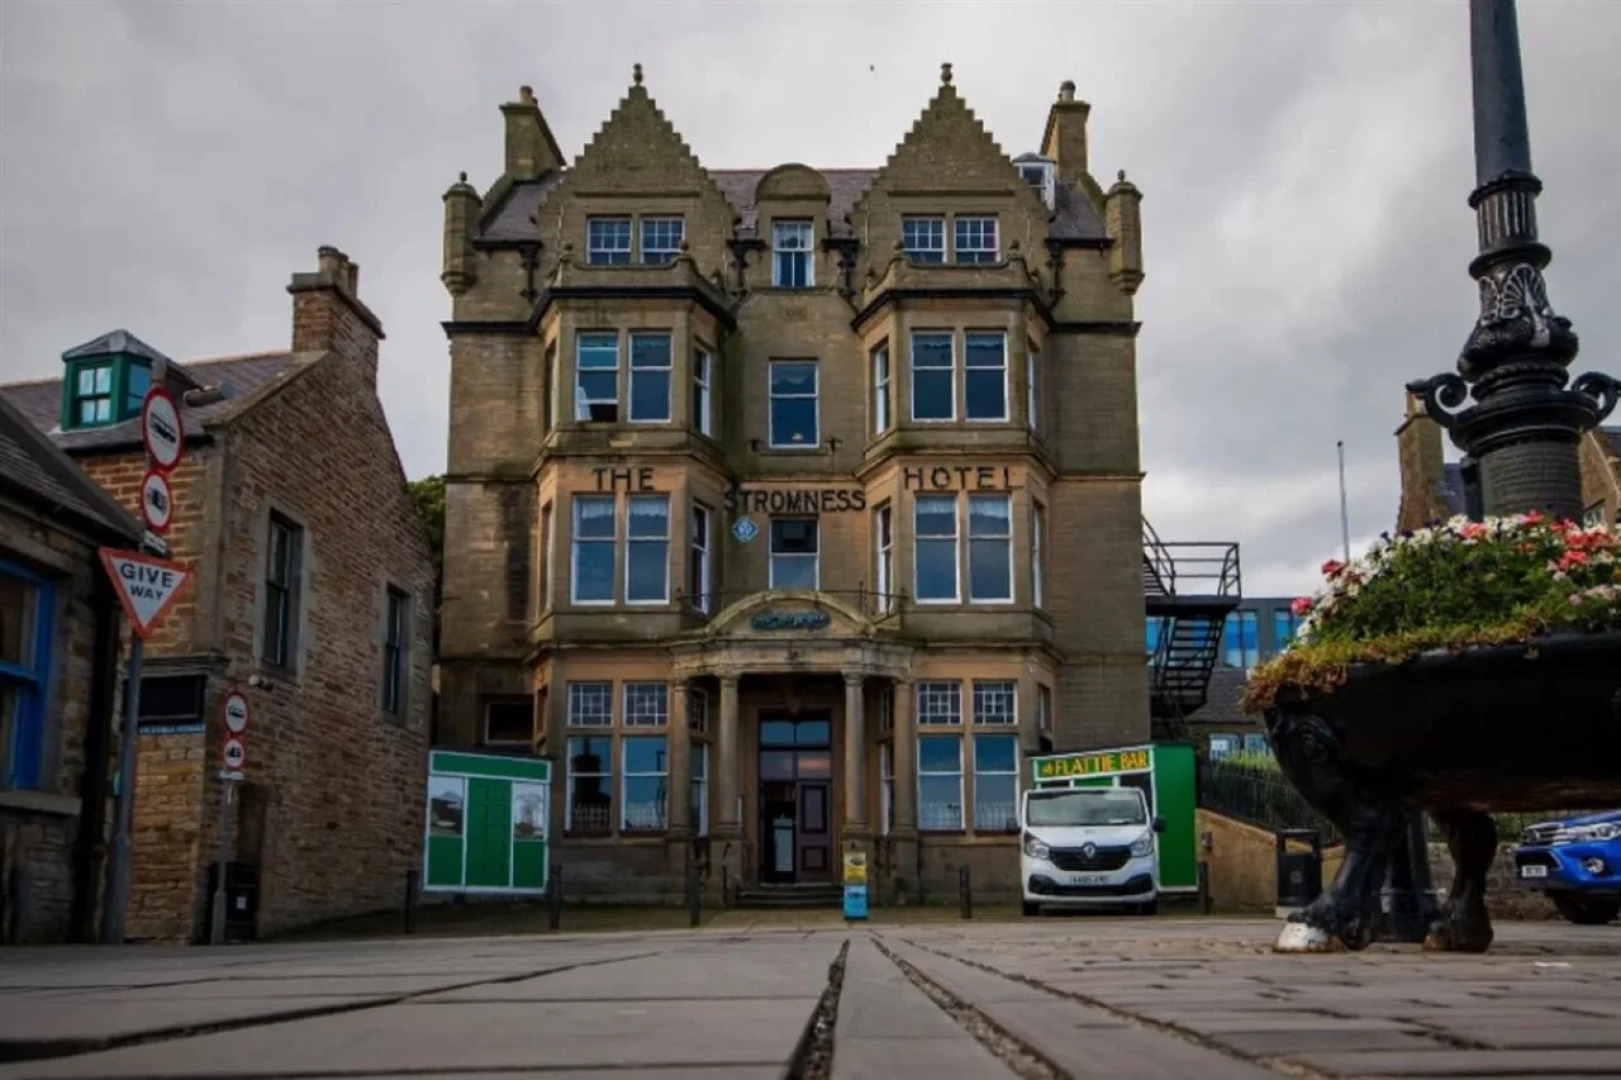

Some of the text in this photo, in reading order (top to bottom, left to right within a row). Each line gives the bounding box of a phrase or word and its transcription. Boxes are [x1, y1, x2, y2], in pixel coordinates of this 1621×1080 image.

[594, 466, 1024, 513] THE STROMNESS HOTEL
[120, 562, 173, 588] GIVE
[131, 585, 163, 601] WAY
[1120, 751, 1147, 770] BAR
